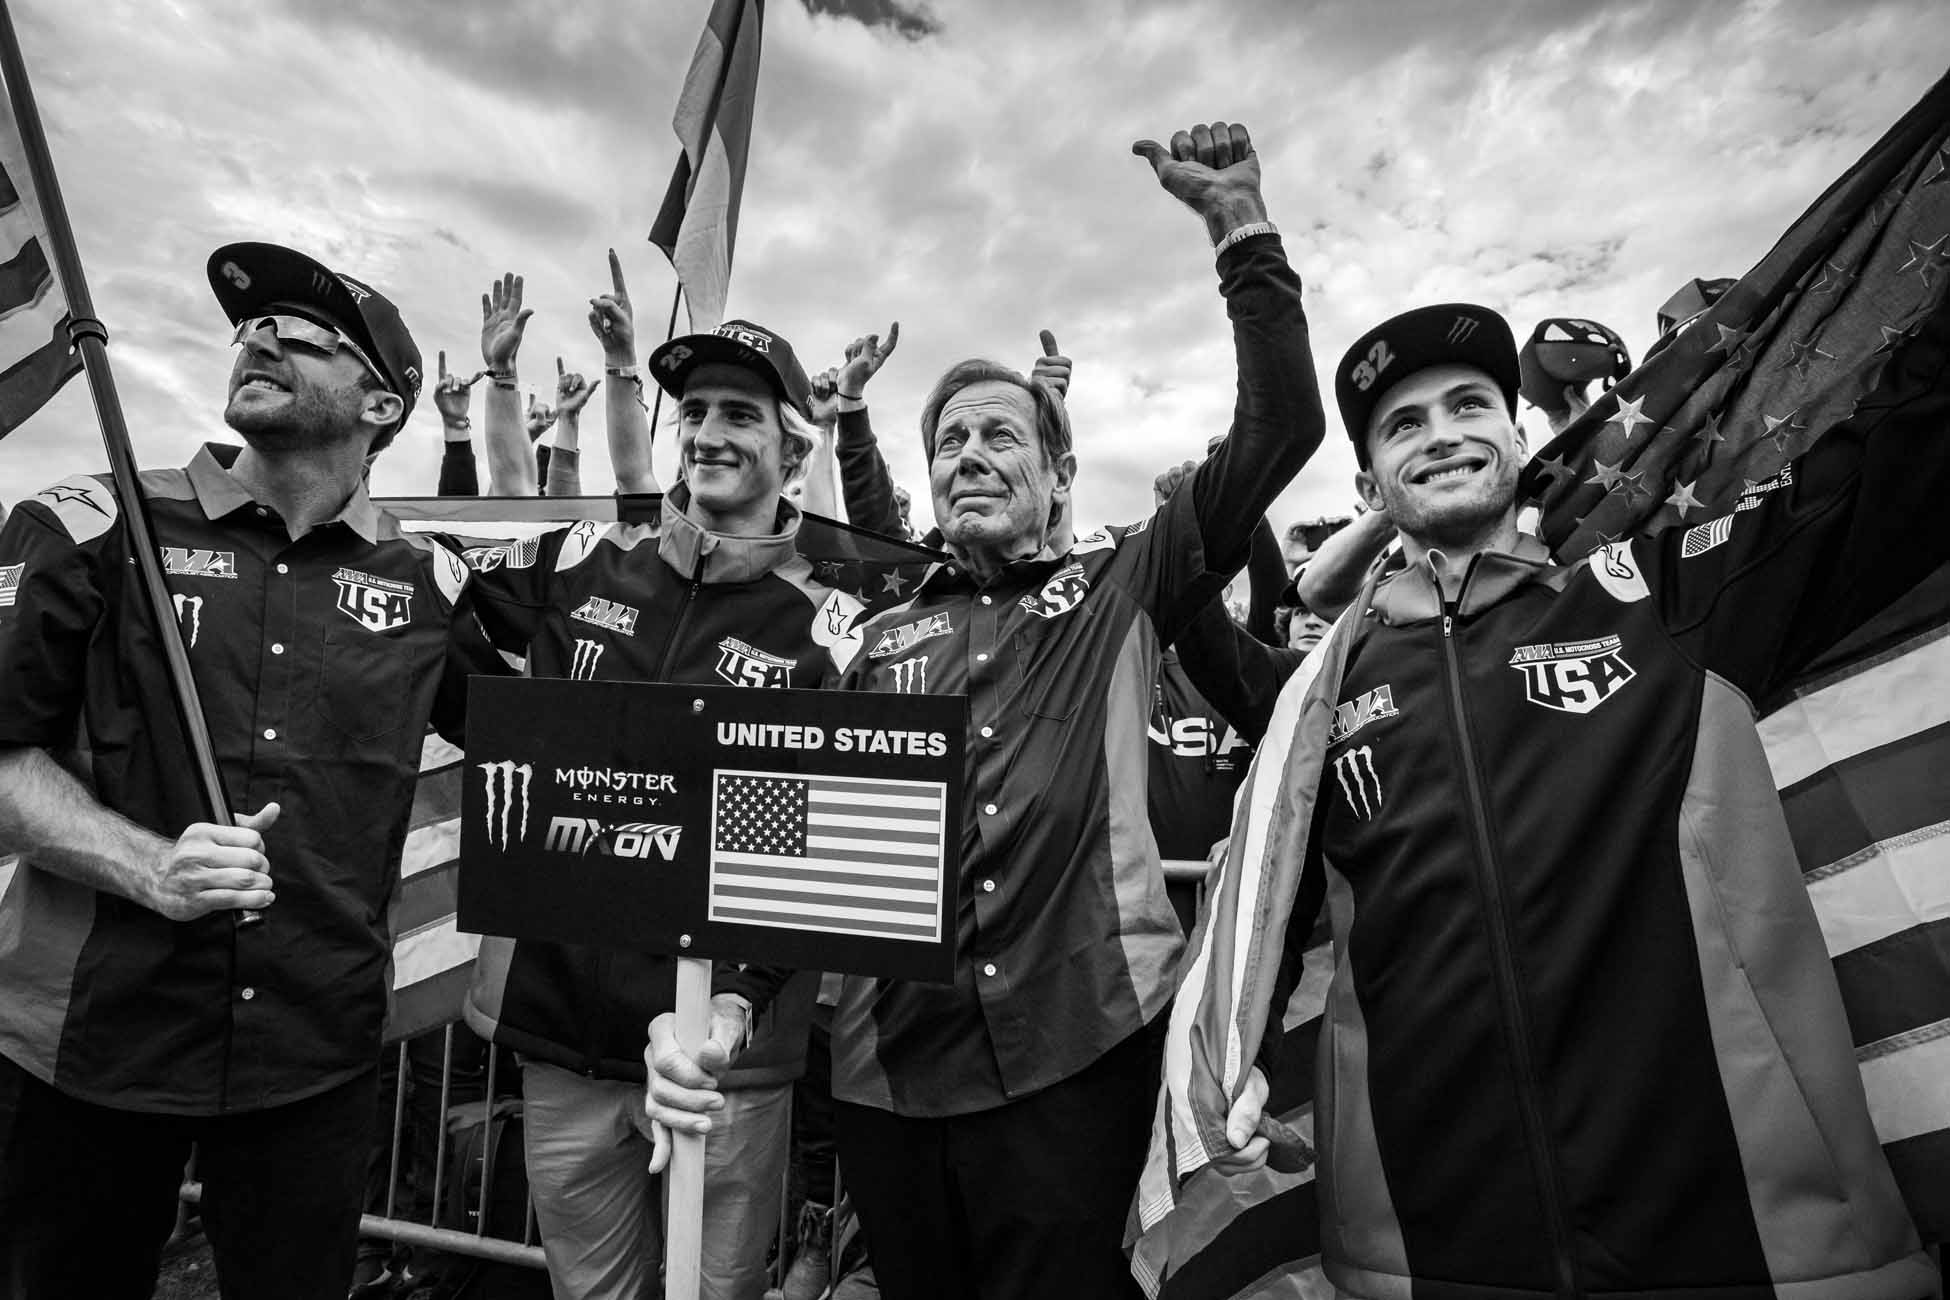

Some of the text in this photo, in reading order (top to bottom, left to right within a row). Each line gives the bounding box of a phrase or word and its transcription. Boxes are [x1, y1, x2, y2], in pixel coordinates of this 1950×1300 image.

[660, 345, 693, 372] 23
[1351, 340, 1396, 391] 32
[338, 583, 411, 632] USA
[571, 596, 639, 633] AMA
[870, 611, 952, 655] AMA
[716, 651, 791, 688] USA
[1508, 643, 1555, 664] AMA
[1526, 656, 1636, 713] USA
[717, 722, 948, 757] UNITED STATES
[555, 766, 677, 794] MONSTER
[573, 792, 659, 806] ENERGY
